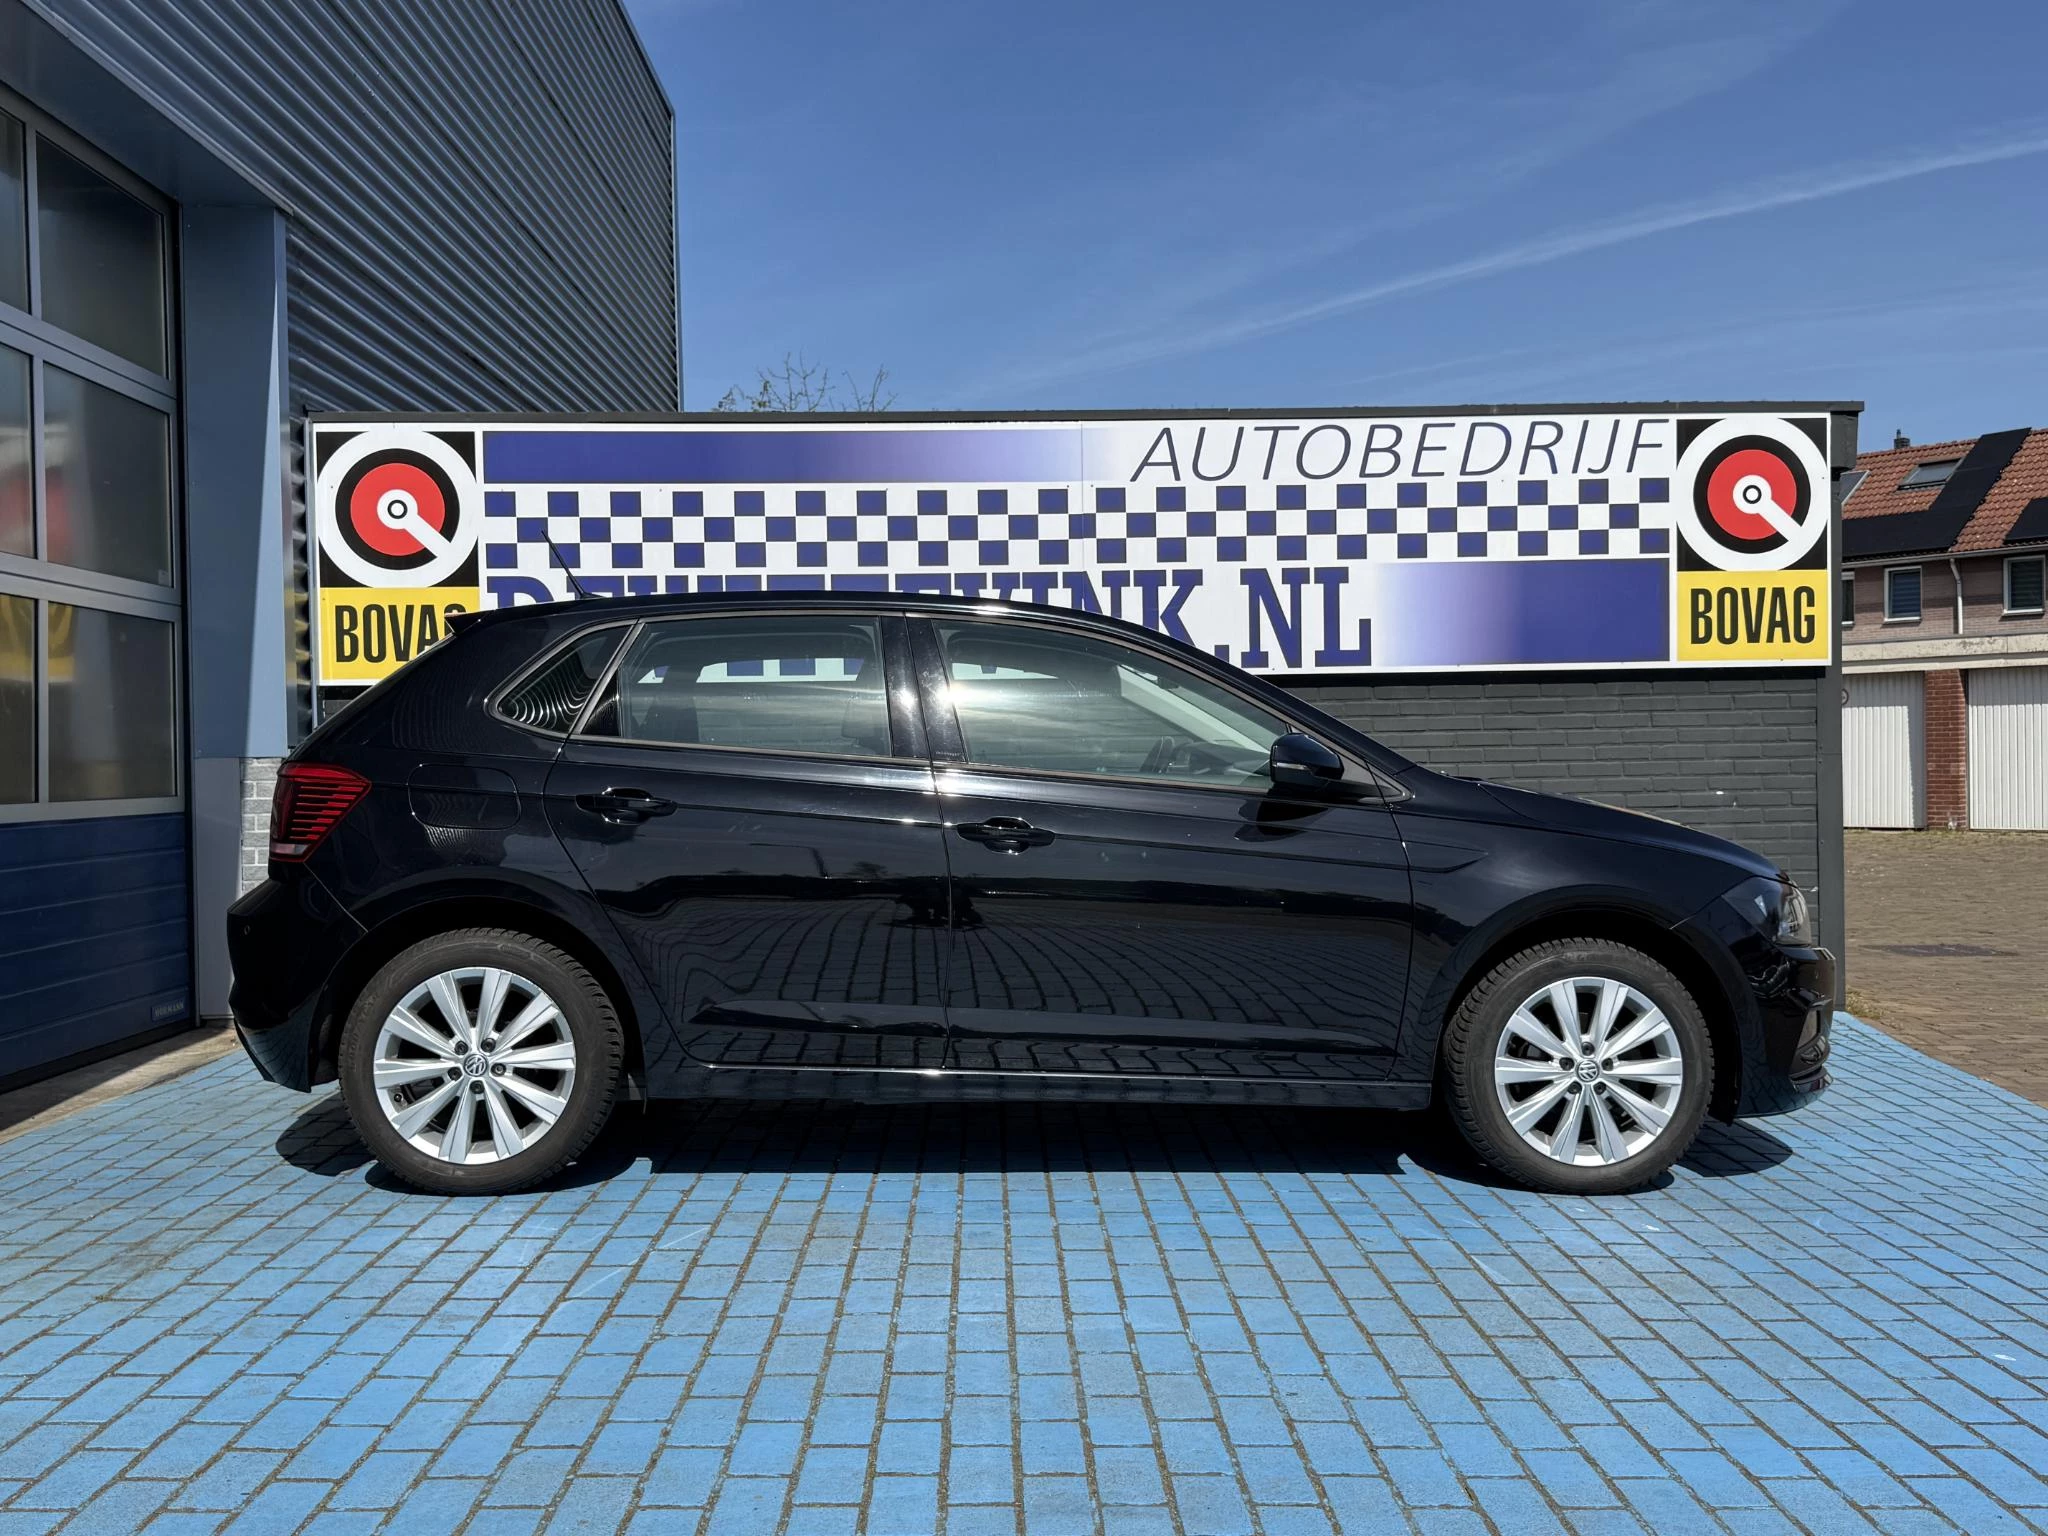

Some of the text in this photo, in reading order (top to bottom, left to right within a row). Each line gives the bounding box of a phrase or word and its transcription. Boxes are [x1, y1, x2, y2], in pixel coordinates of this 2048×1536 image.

[1129, 418, 1670, 482] AUTOBEDRIJF
[334, 603, 467, 663] BOVA
[1690, 585, 1816, 645] BOVAG
